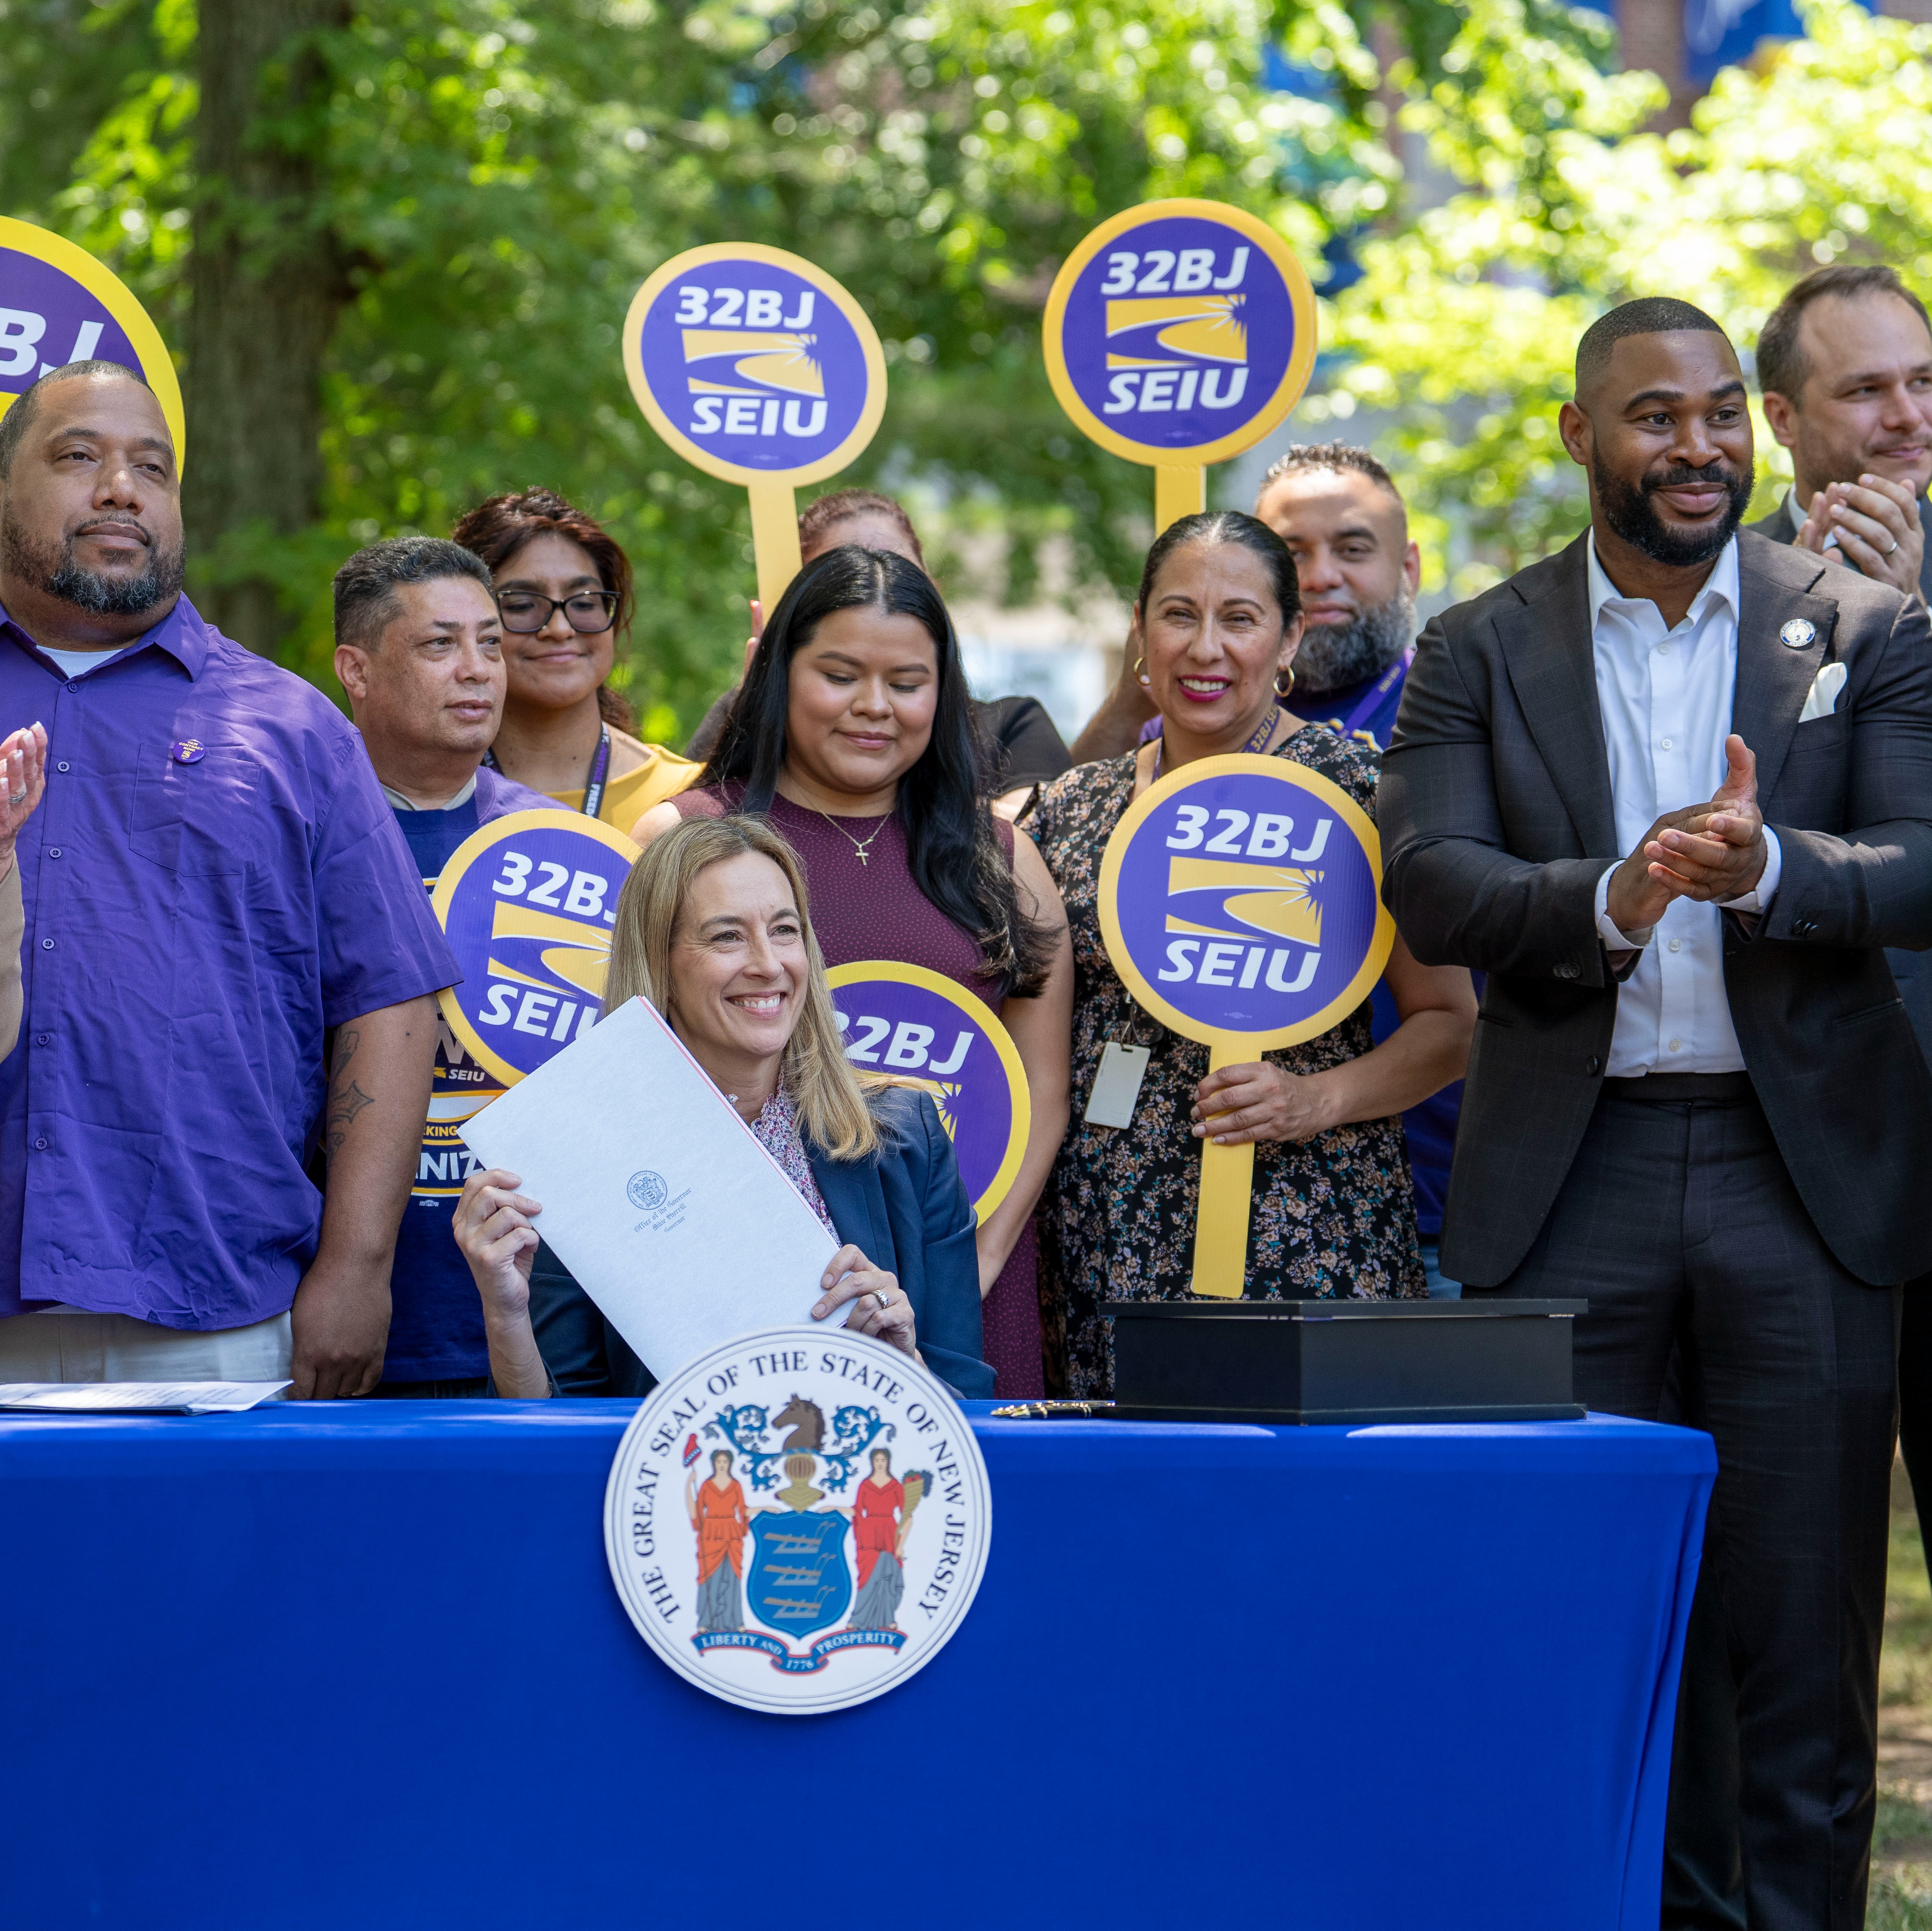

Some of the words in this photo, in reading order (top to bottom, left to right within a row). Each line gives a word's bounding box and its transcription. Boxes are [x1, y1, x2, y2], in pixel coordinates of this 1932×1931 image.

[1101, 246, 1250, 295] 32BJ
[675, 286, 815, 329] 32BJ
[1103, 368, 1249, 414] SEIU
[690, 397, 828, 437] SEIU
[179, 742, 203, 751] CONTRACT
[1251, 721, 1271, 751] 32BJ
[586, 784, 601, 817] FREED
[1166, 805, 1333, 862] 32BJ
[492, 851, 617, 924] 32B
[1158, 939, 1322, 992] SEIU
[448, 1069, 485, 1082] SEIU
[424, 1125, 457, 1137] KING
[416, 1150, 483, 1180] NIZ
[634, 1219, 651, 1233] Office
[667, 1188, 691, 1207] Governor
[664, 1216, 685, 1233] Governor
[666, 1203, 686, 1220] Sherrill
[707, 1365, 739, 1396] OF
[749, 1351, 808, 1377] THE
[820, 1353, 904, 1404] STATE
[651, 1396, 706, 1457] SEAL
[906, 1403, 939, 1435] OF
[929, 1440, 965, 1506] NEW
[633, 1462, 660, 1557] GREAT
[918, 1514, 966, 1620] JERSEY
[642, 1566, 681, 1624] THE
[701, 1634, 758, 1647] LIBERTY
[759, 1640, 783, 1655] AND
[817, 1634, 896, 1655] PROSPERITY
[786, 1659, 814, 1669] 1776
